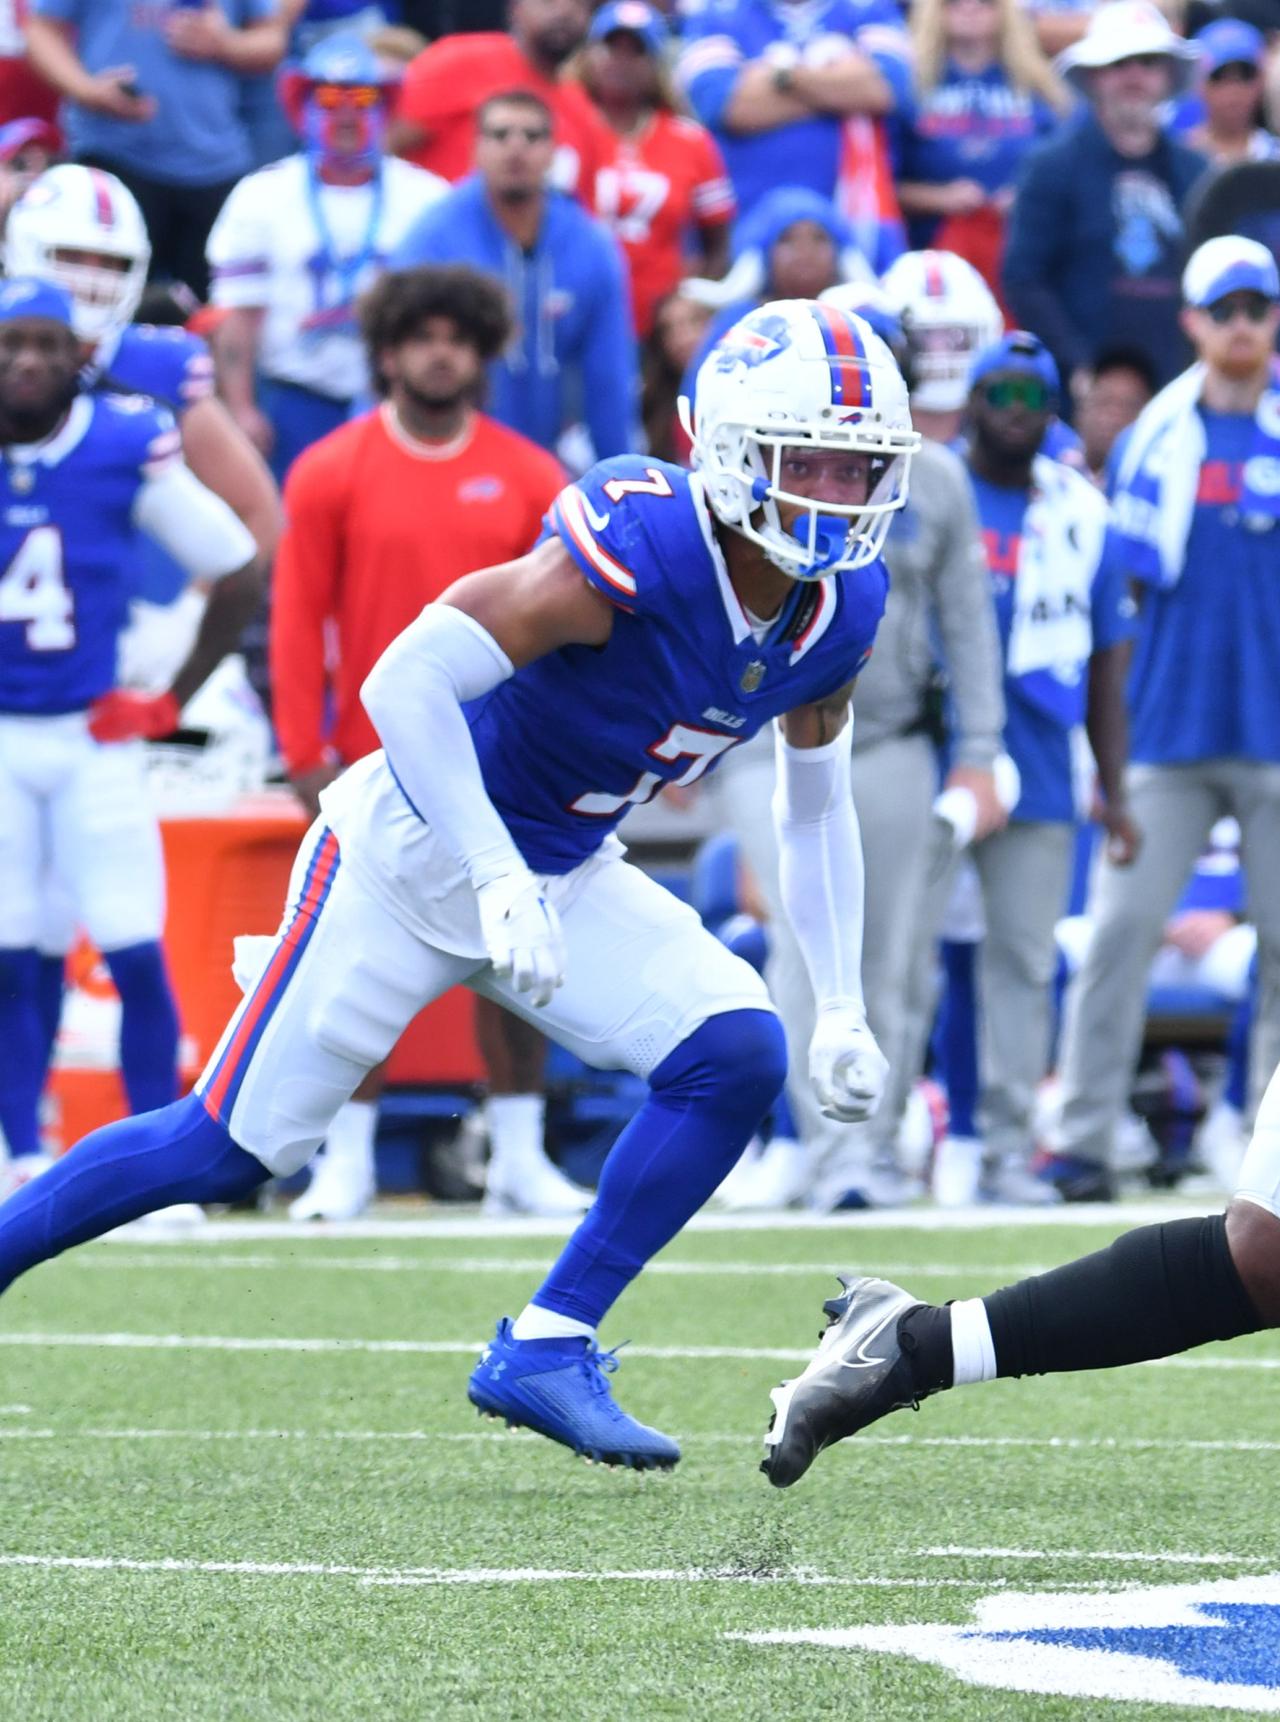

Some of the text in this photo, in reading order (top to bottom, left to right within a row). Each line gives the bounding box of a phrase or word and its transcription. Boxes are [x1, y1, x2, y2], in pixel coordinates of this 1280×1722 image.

[594, 167, 671, 242] 17
[601, 467, 676, 505] 7
[0, 525, 75, 651] 4
[701, 706, 747, 728] BILLS
[565, 721, 745, 818] 7
